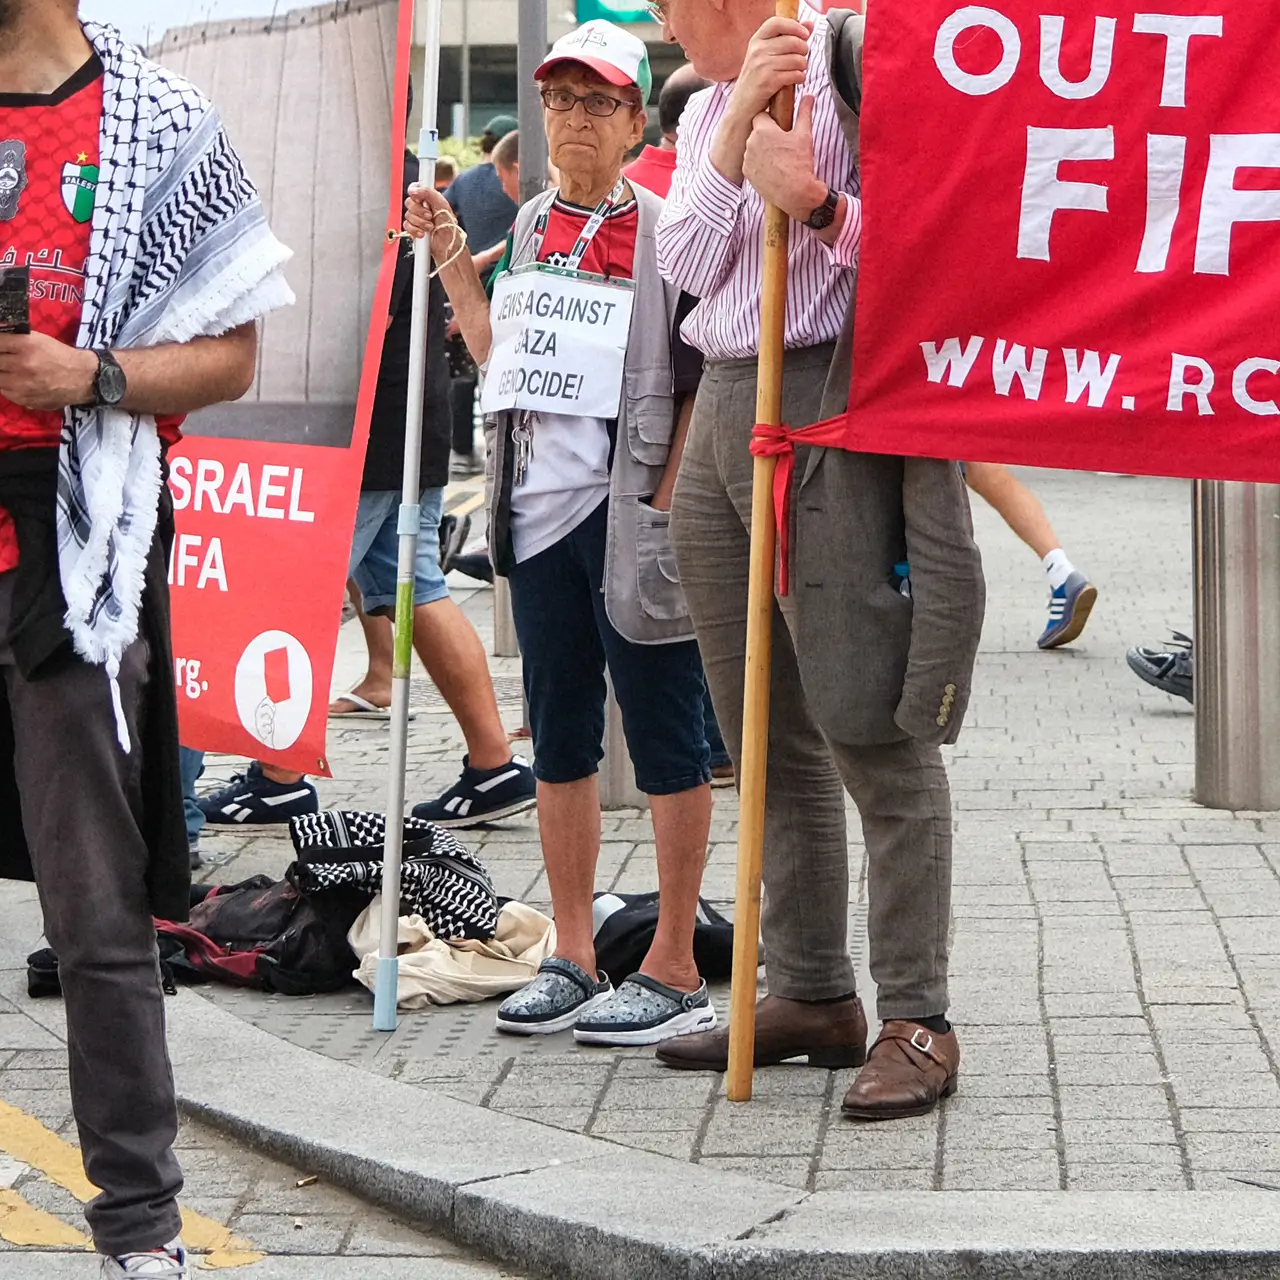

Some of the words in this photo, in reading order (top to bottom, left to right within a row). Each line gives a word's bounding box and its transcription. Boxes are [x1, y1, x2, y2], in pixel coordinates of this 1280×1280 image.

[932, 5, 1224, 108] OUT
[497, 291, 524, 322] JEWS
[523, 289, 617, 326] AGAINST
[498, 367, 585, 401] GENOCIDE!
[169, 455, 316, 523] SRAEL
[167, 532, 229, 592] IFA
